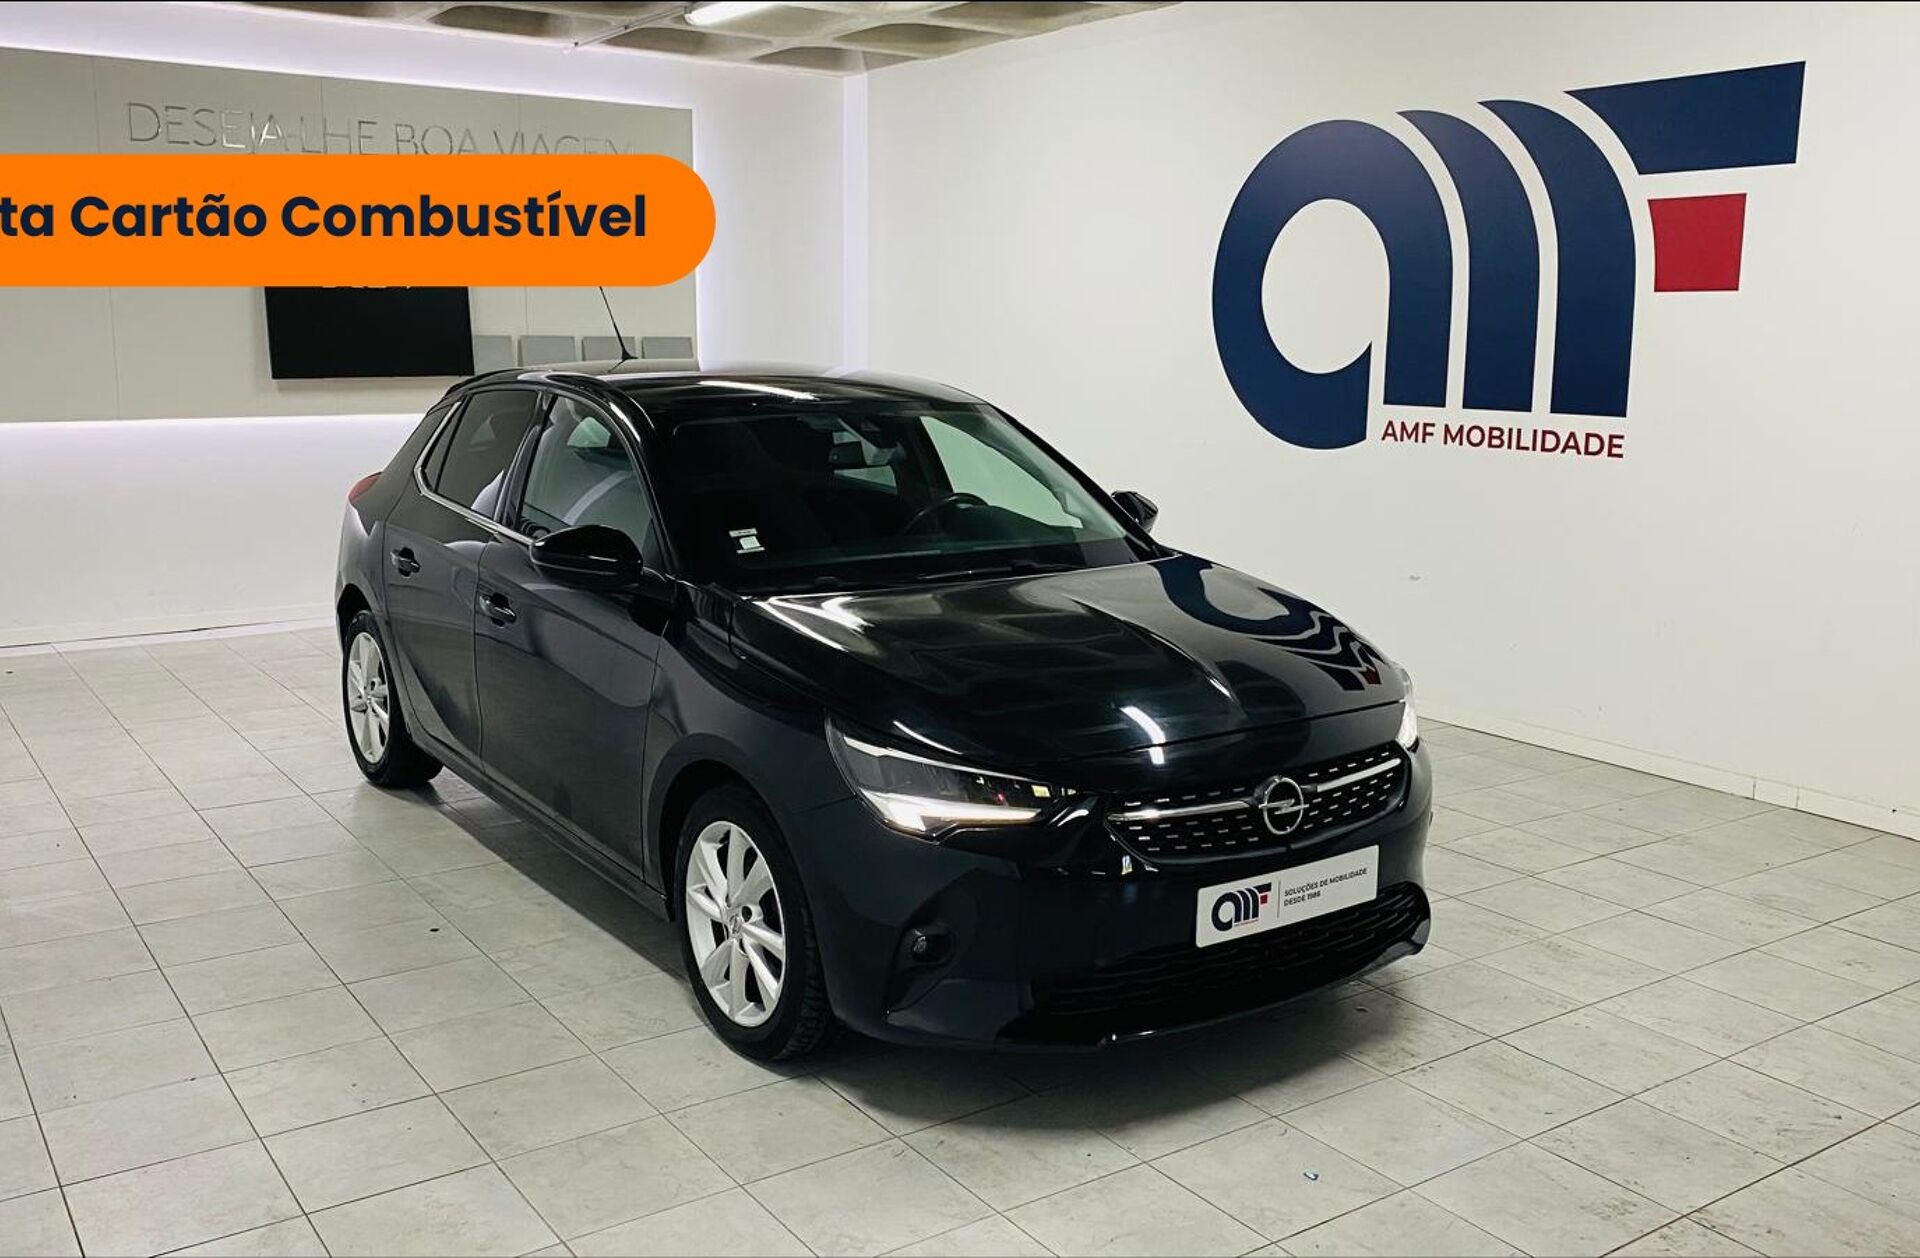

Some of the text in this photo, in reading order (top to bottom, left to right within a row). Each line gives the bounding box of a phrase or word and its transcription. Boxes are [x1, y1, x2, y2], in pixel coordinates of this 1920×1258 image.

[394, 123, 478, 155] BOA
[1381, 420, 1625, 459] AMF MOBILIDADE
[1319, 878, 1328, 888] DE
[1329, 867, 1367, 884] MOBILIDADE
[1283, 894, 1306, 907] DESDE
